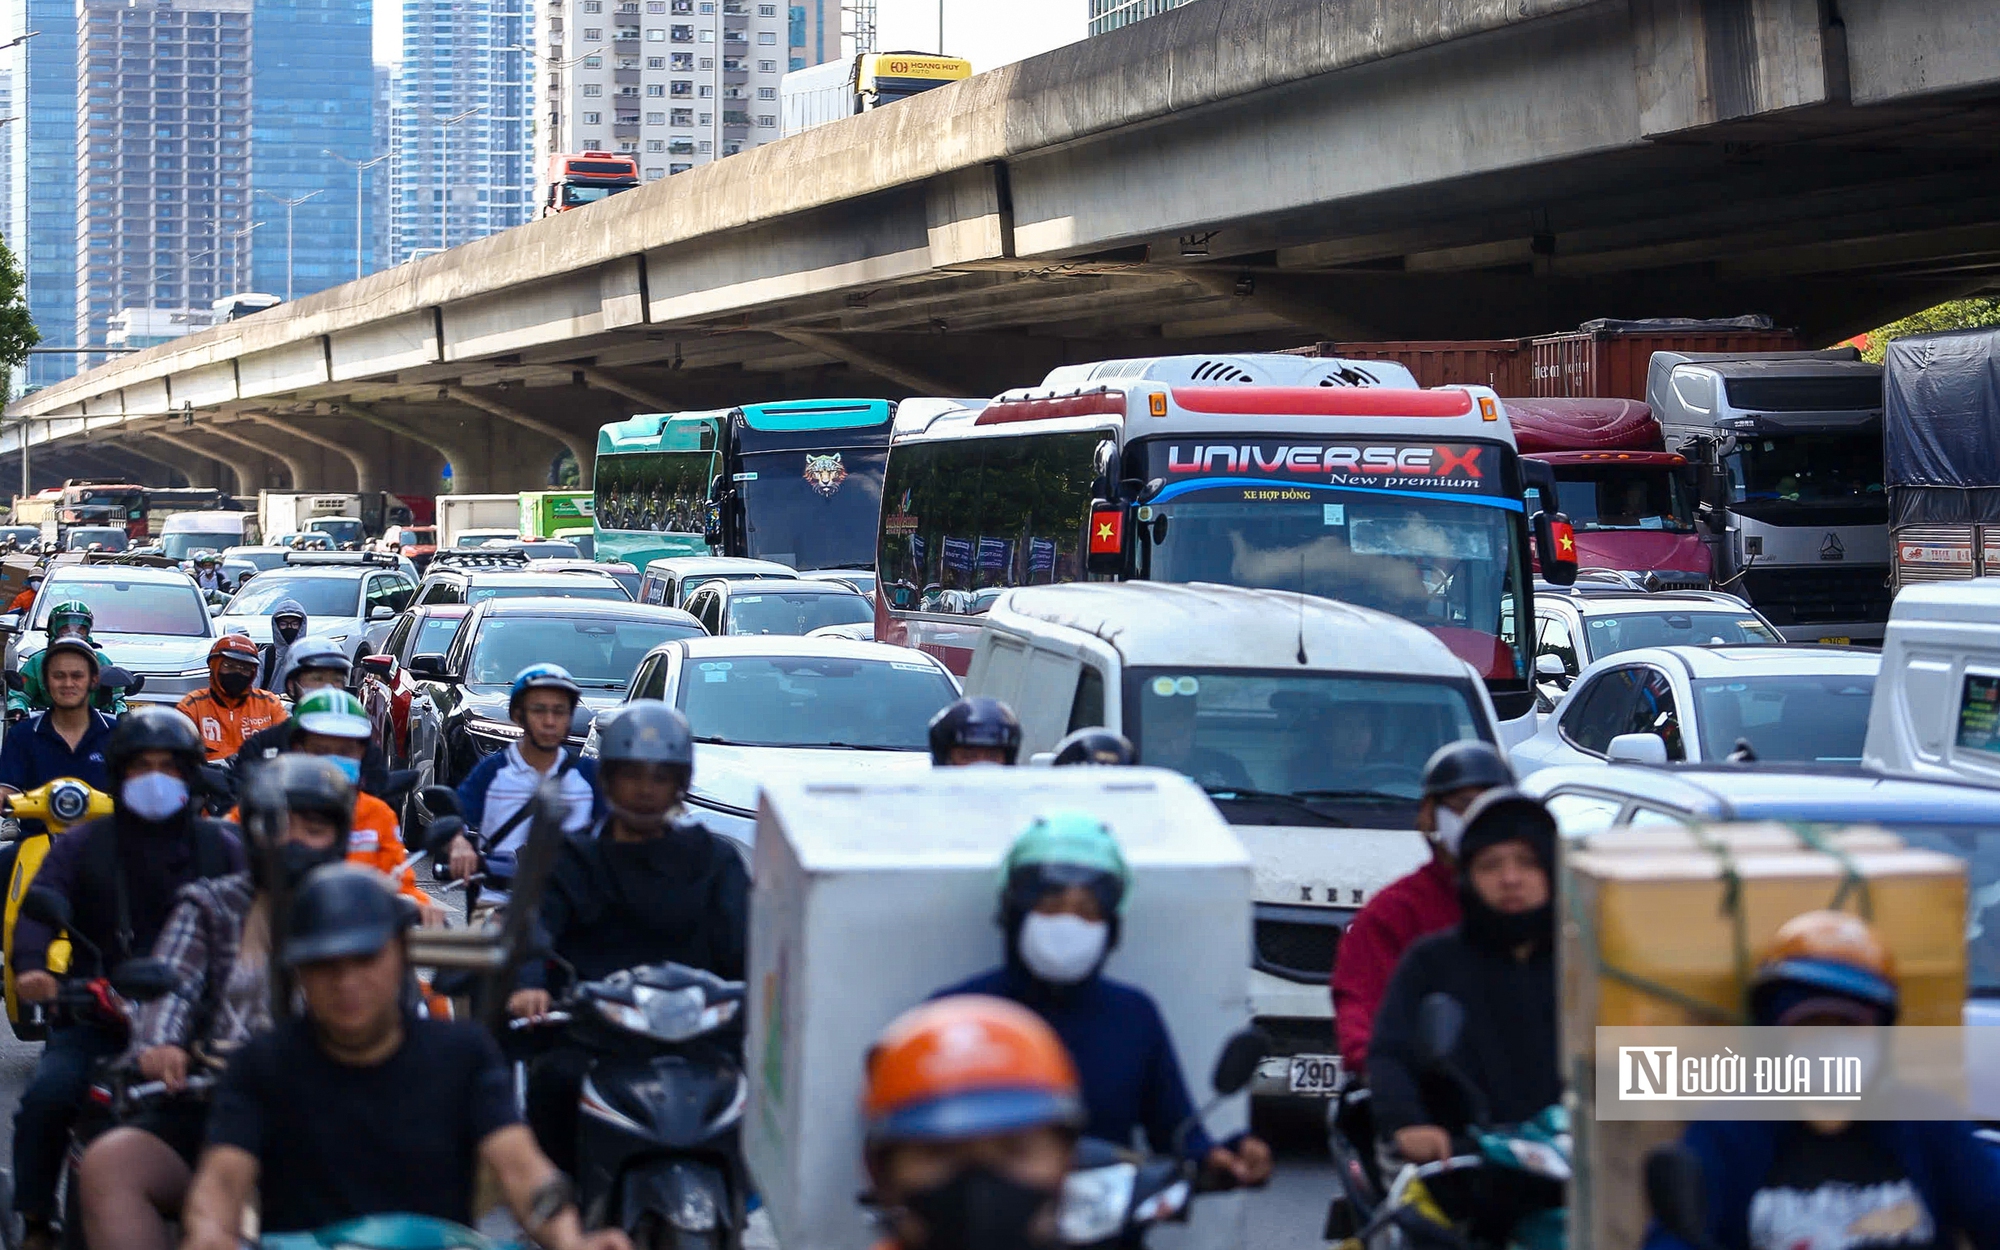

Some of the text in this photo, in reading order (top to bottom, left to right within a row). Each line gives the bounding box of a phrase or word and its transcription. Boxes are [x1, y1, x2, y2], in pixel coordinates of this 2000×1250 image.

[1330, 473, 1481, 489] New premium
[1243, 488, 1311, 501] XE HỢP ĐỒNG
